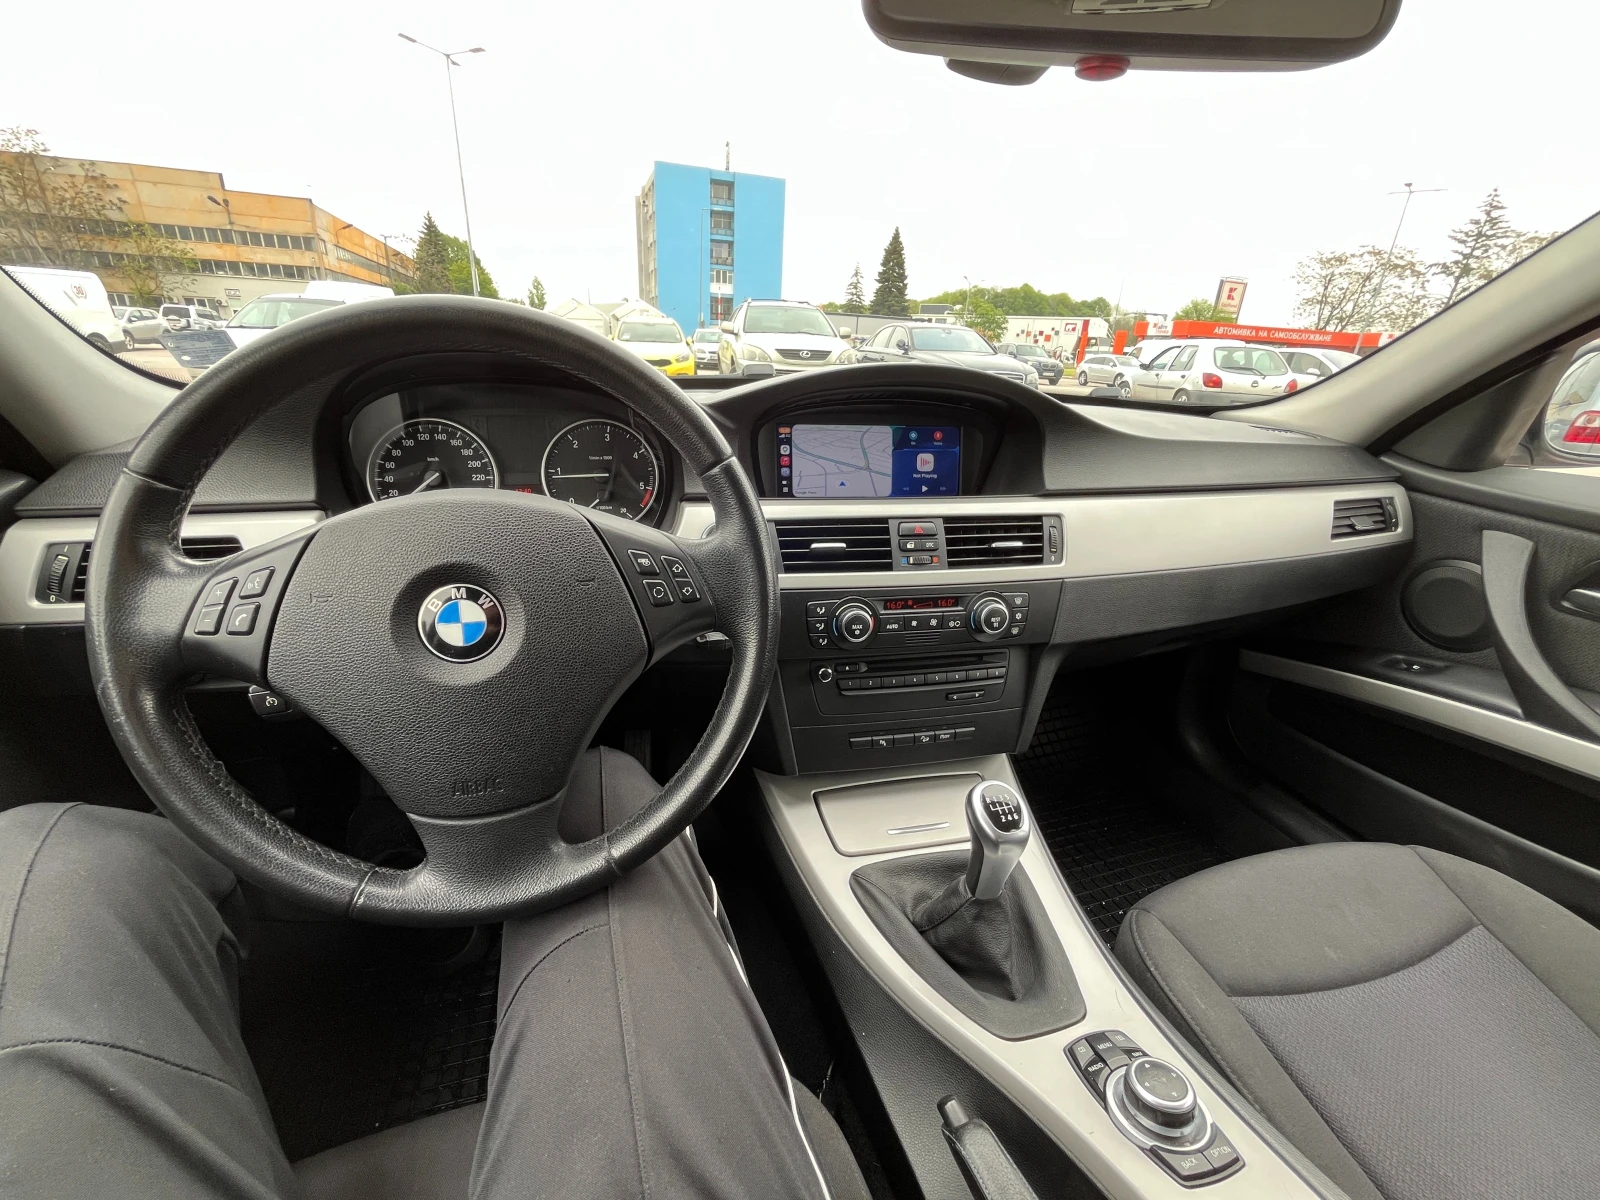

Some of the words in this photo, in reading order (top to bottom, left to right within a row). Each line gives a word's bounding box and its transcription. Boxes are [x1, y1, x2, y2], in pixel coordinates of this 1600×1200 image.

[1213, 326, 1256, 337] АВТОМИВКА
[1258, 330, 1268, 338] НА
[1270, 330, 1333, 342] САМООБСЛУЖВАНЕ
[416, 433, 430, 441] 120
[433, 433, 447, 441] 140
[604, 433, 610, 441] 3
[401, 439, 415, 447] 100
[449, 439, 463, 447] 160
[573, 440, 579, 449] 2
[391, 449, 401, 457] 80
[633, 452, 639, 460] 4
[385, 461, 395, 469] 60
[556, 467, 561, 475] 1
[639, 482, 645, 490] 5
[388, 489, 399, 497] 20
[426, 587, 495, 613] BMW
[453, 779, 505, 798] AIRBAG
[1013, 812, 1019, 820] 6
[1097, 1041, 1113, 1050] MENU
[1087, 1062, 1104, 1073] RADIO
[1210, 1145, 1232, 1158] OPTION
[1180, 1156, 1199, 1170] BACK
